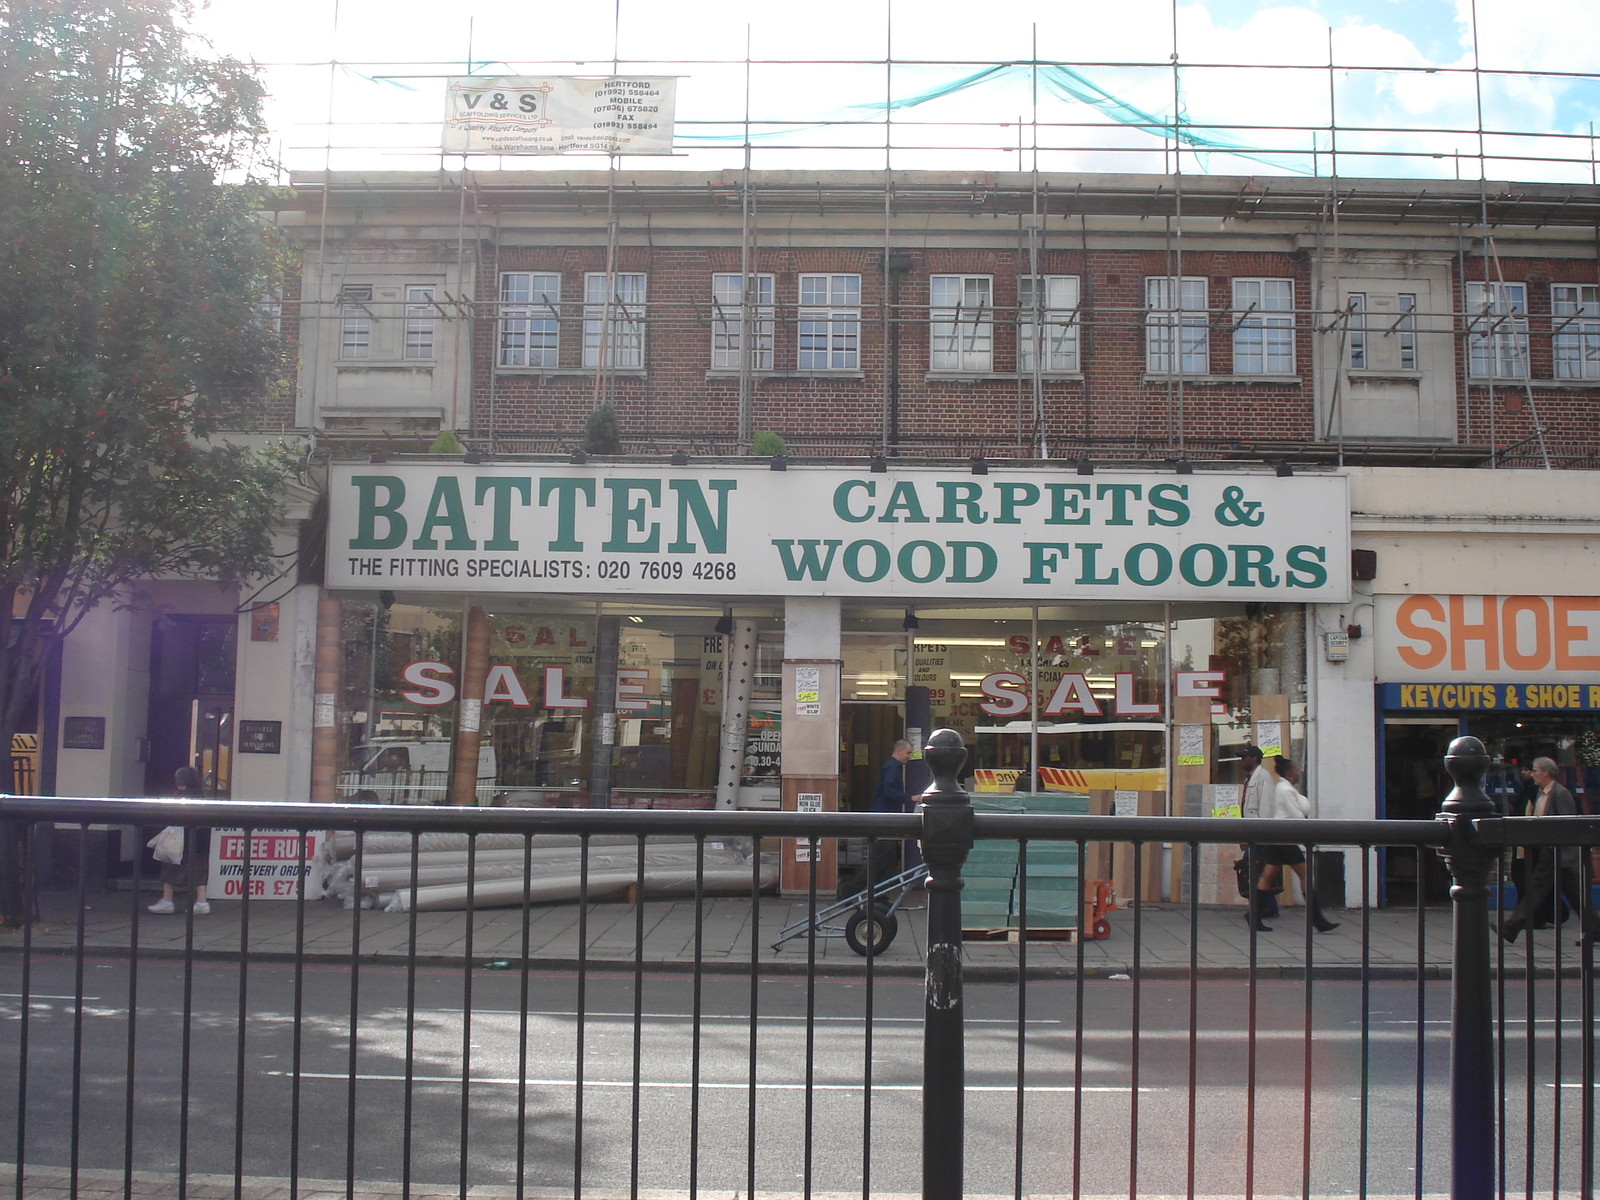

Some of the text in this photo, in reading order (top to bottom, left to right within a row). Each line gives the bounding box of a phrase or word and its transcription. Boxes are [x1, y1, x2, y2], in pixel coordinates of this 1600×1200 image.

[604, 81, 651, 89] HERTFORD
[594, 89, 625, 98] (01992)
[609, 97, 643, 105] MOBILE
[463, 93, 537, 113] V & S
[593, 105, 659, 114] (07836) 675820
[463, 123, 486, 133] Quality
[487, 124, 510, 132] Assured
[512, 125, 539, 134] Company
[593, 121, 625, 130] (01992)
[558, 142, 588, 151] Hertford
[832, 479, 1265, 528] CARPETS &
[348, 475, 738, 554] BATTEN
[348, 557, 737, 582] THE FITTING SPECIALISTS: 020 7609 4268
[771, 538, 1328, 589] WOOD FLOORS
[505, 625, 596, 648] SAL
[1395, 594, 1600, 671] SHOE
[1009, 635, 1137, 655] SALE
[915, 658, 944, 666] QUALITIES
[913, 674, 937, 682] OLOURS
[1027, 671, 1063, 683] SECIAL
[401, 660, 651, 712] SALE
[980, 670, 1228, 717] SALE
[1400, 684, 1600, 709] KEYCUTS & SHOE R
[752, 741, 782, 753] SUNDA
[248, 864, 278, 877] EVERY
[279, 865, 312, 877] ORDR
[224, 879, 265, 896] OVER
